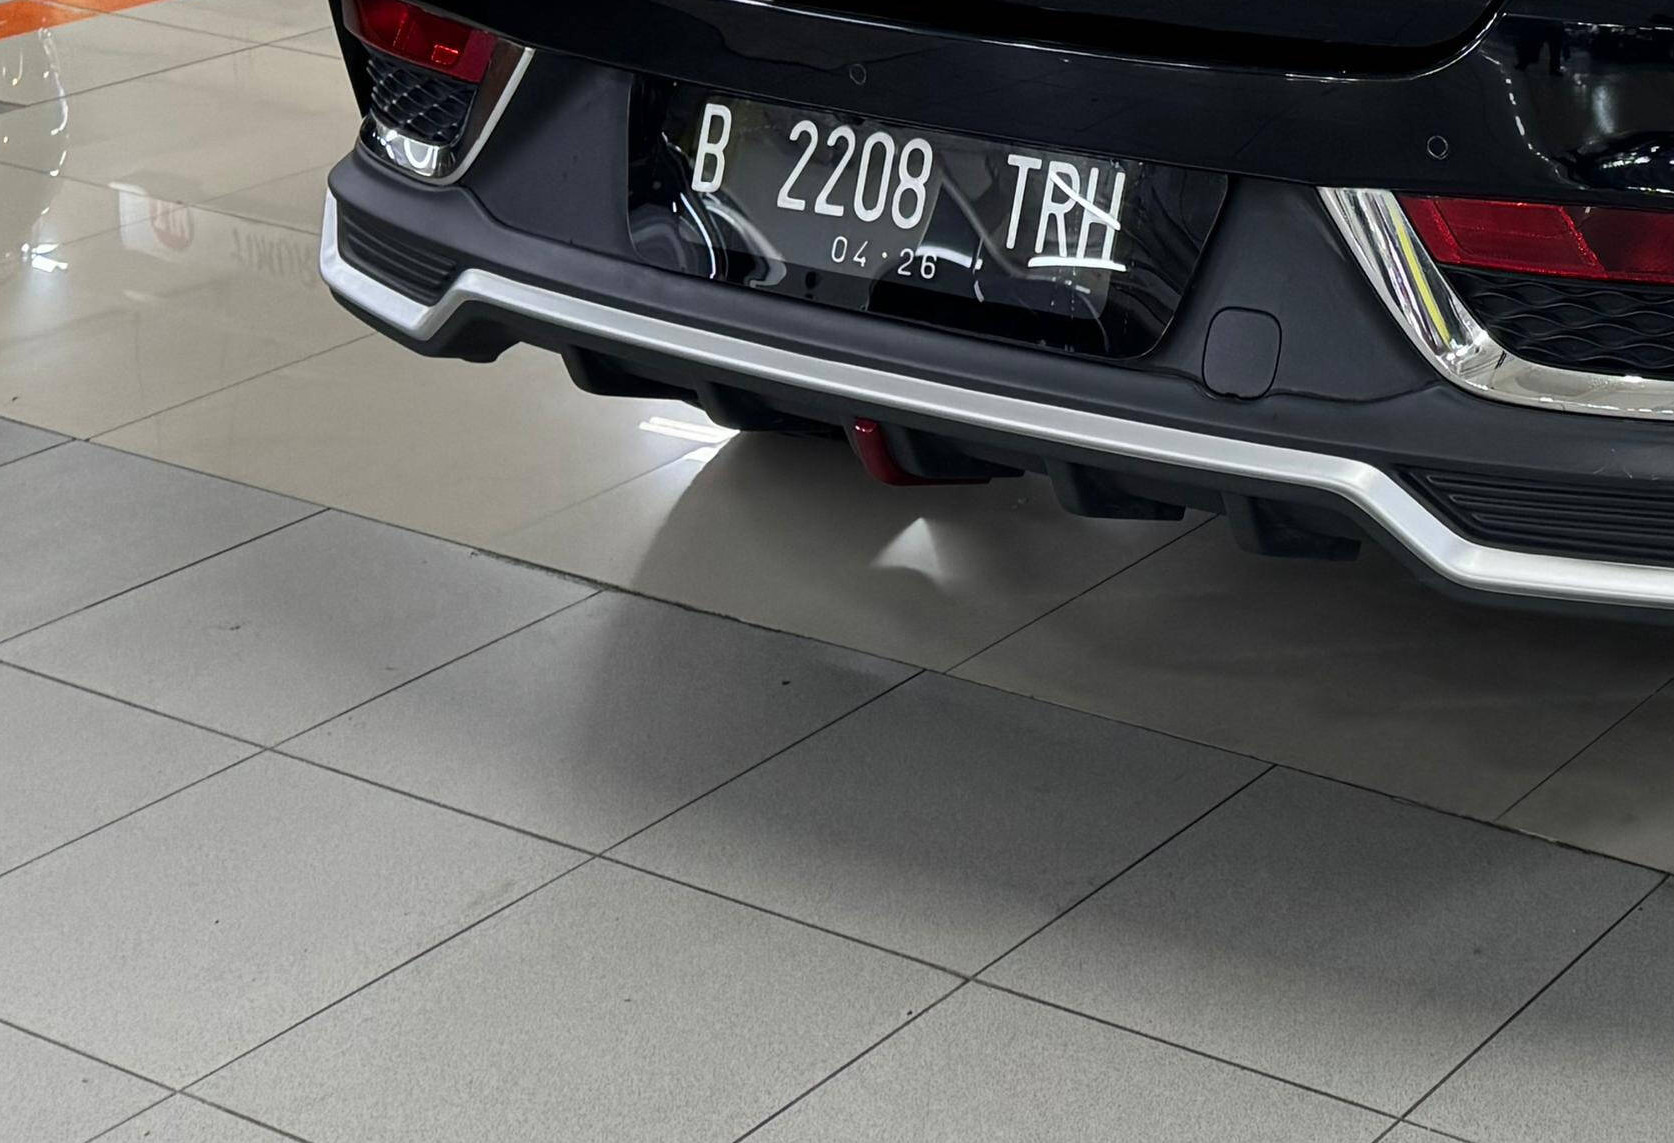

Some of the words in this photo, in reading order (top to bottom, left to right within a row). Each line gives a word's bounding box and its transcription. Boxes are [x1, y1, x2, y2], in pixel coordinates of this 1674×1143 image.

[691, 103, 732, 193] B
[777, 120, 933, 229] 2208
[1006, 154, 1126, 261] TRH
